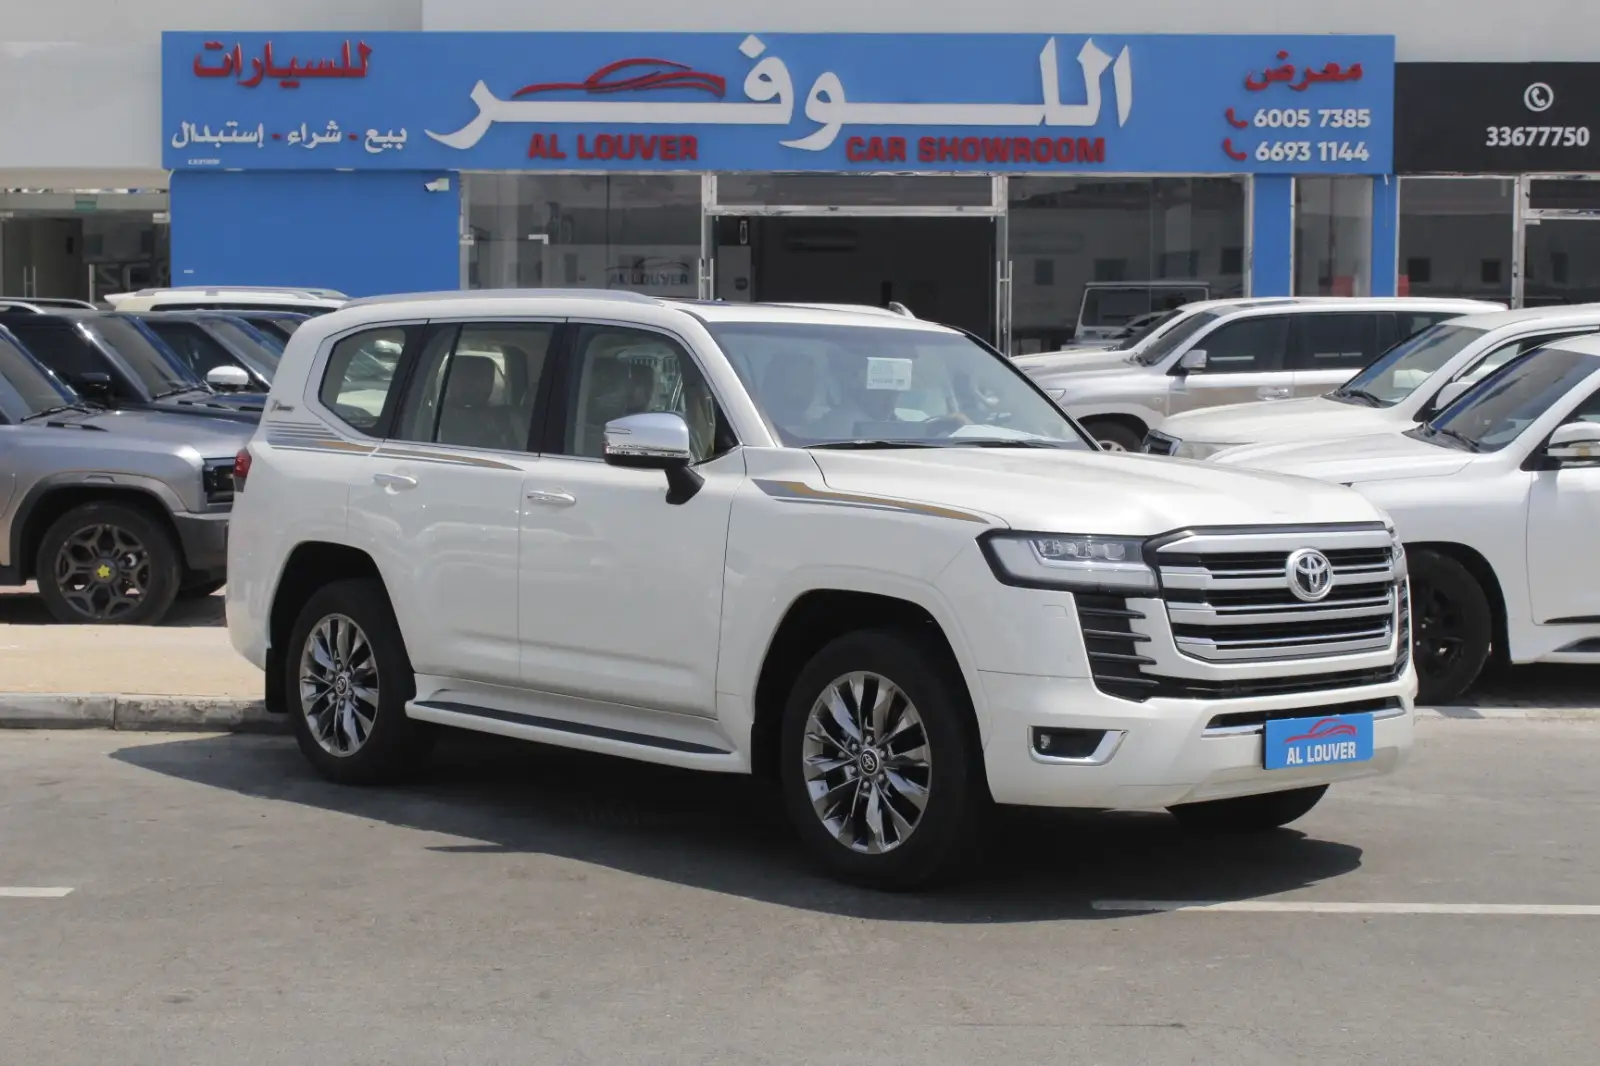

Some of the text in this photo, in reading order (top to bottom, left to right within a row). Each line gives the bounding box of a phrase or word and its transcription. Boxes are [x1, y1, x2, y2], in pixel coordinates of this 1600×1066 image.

[193, 39, 372, 88] للسيارات
[1245, 50, 1363, 90] معرض
[1253, 108, 1371, 128] 6005 7385
[171, 120, 265, 148] إستبدال
[287, 120, 342, 148] شراء
[365, 127, 407, 153] بيع
[528, 133, 698, 161] AL LOUVER
[1486, 126, 1590, 147] 33677750
[845, 136, 1105, 162] CAR SHOWROOM
[1255, 140, 1370, 161] 6693 1144
[1286, 741, 1356, 764] AL LOUVER
